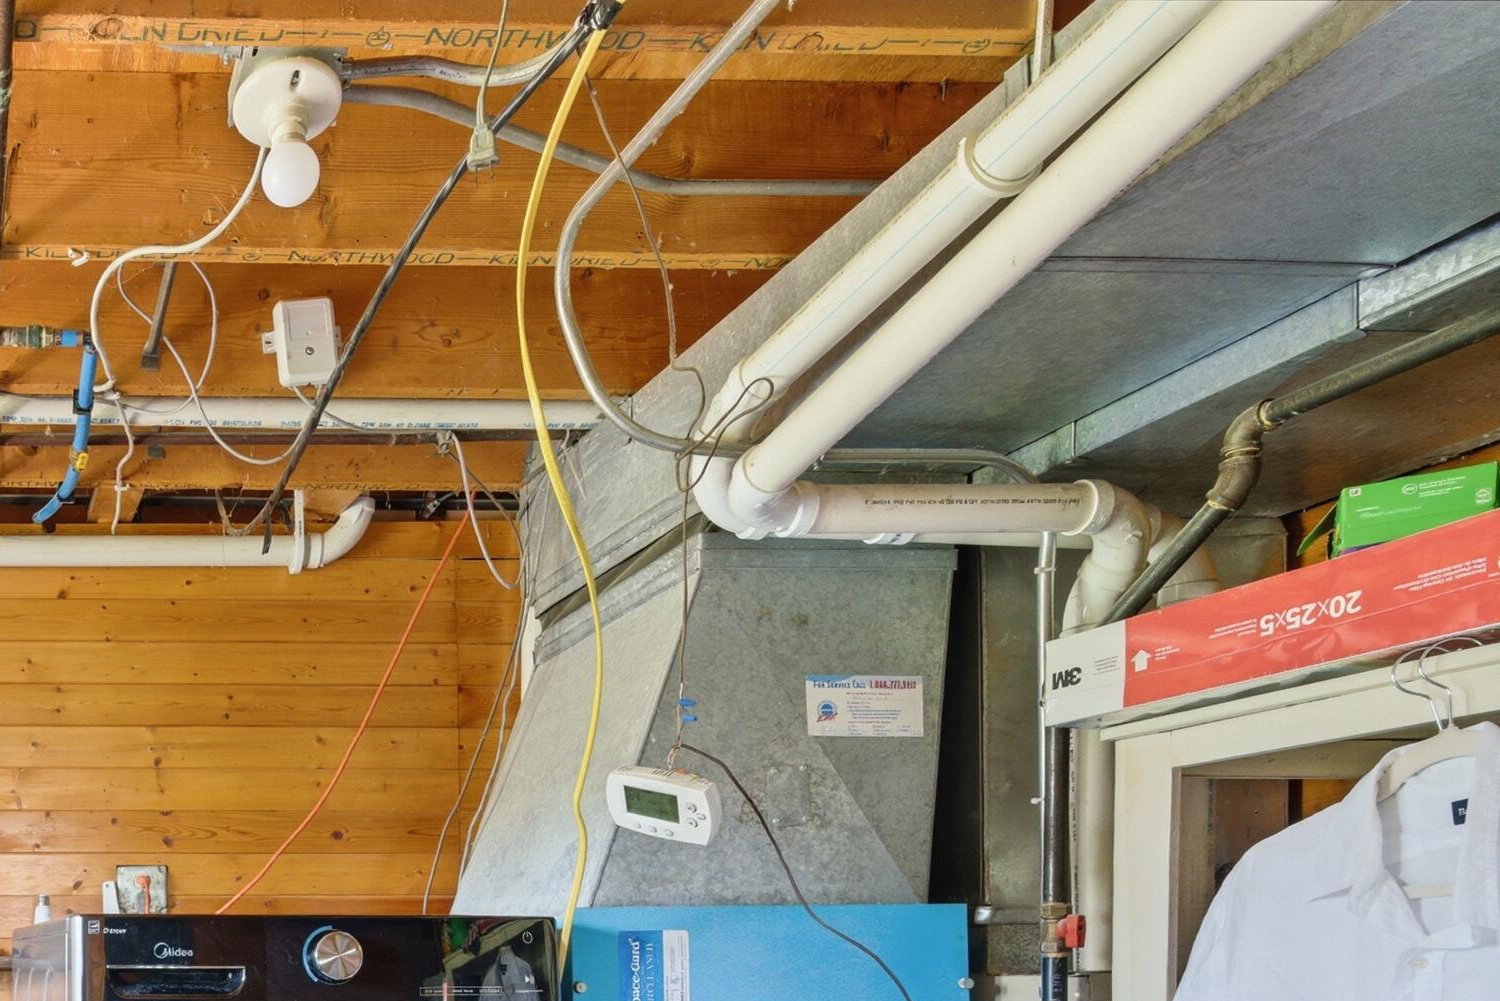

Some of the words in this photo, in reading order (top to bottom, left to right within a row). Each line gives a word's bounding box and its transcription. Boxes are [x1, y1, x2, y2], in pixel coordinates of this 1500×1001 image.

[424, 27, 646, 50] NORTHWOD
[1259, 589, 1363, 638] 20x25x5
[1051, 666, 1083, 691] 3M
[153, 942, 194, 959] Midea
